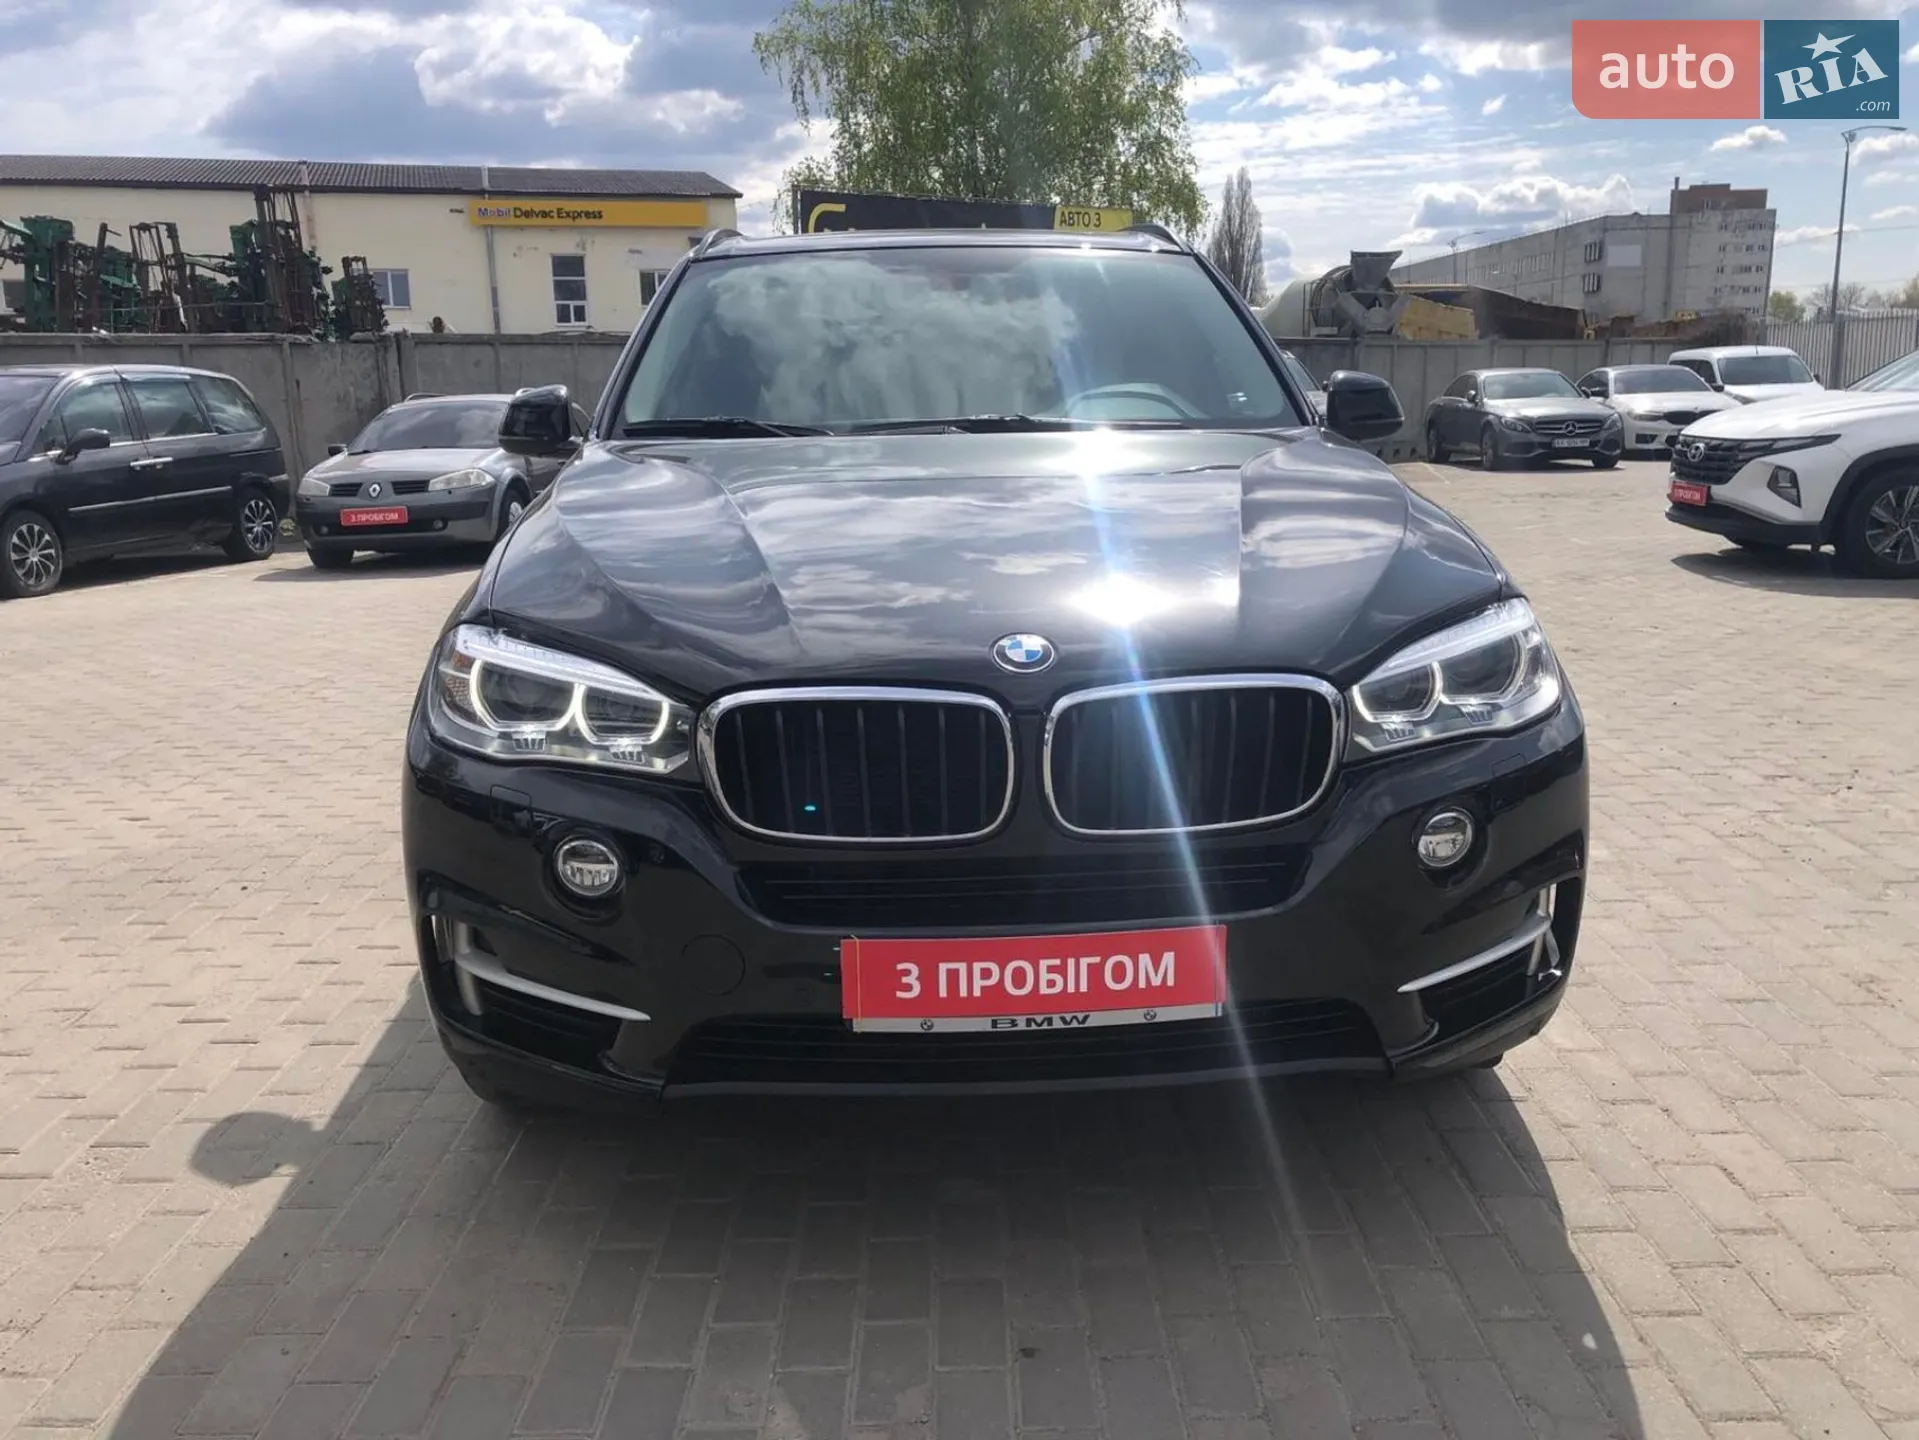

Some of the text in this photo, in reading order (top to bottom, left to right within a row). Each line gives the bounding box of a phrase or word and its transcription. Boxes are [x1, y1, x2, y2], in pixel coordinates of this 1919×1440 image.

[478, 207, 604, 222] Mobil Delvac Express
[1059, 210, 1091, 228] АВТО
[938, 951, 1176, 998] ПРОБІГОМ
[990, 1014, 1091, 1030] BMW
